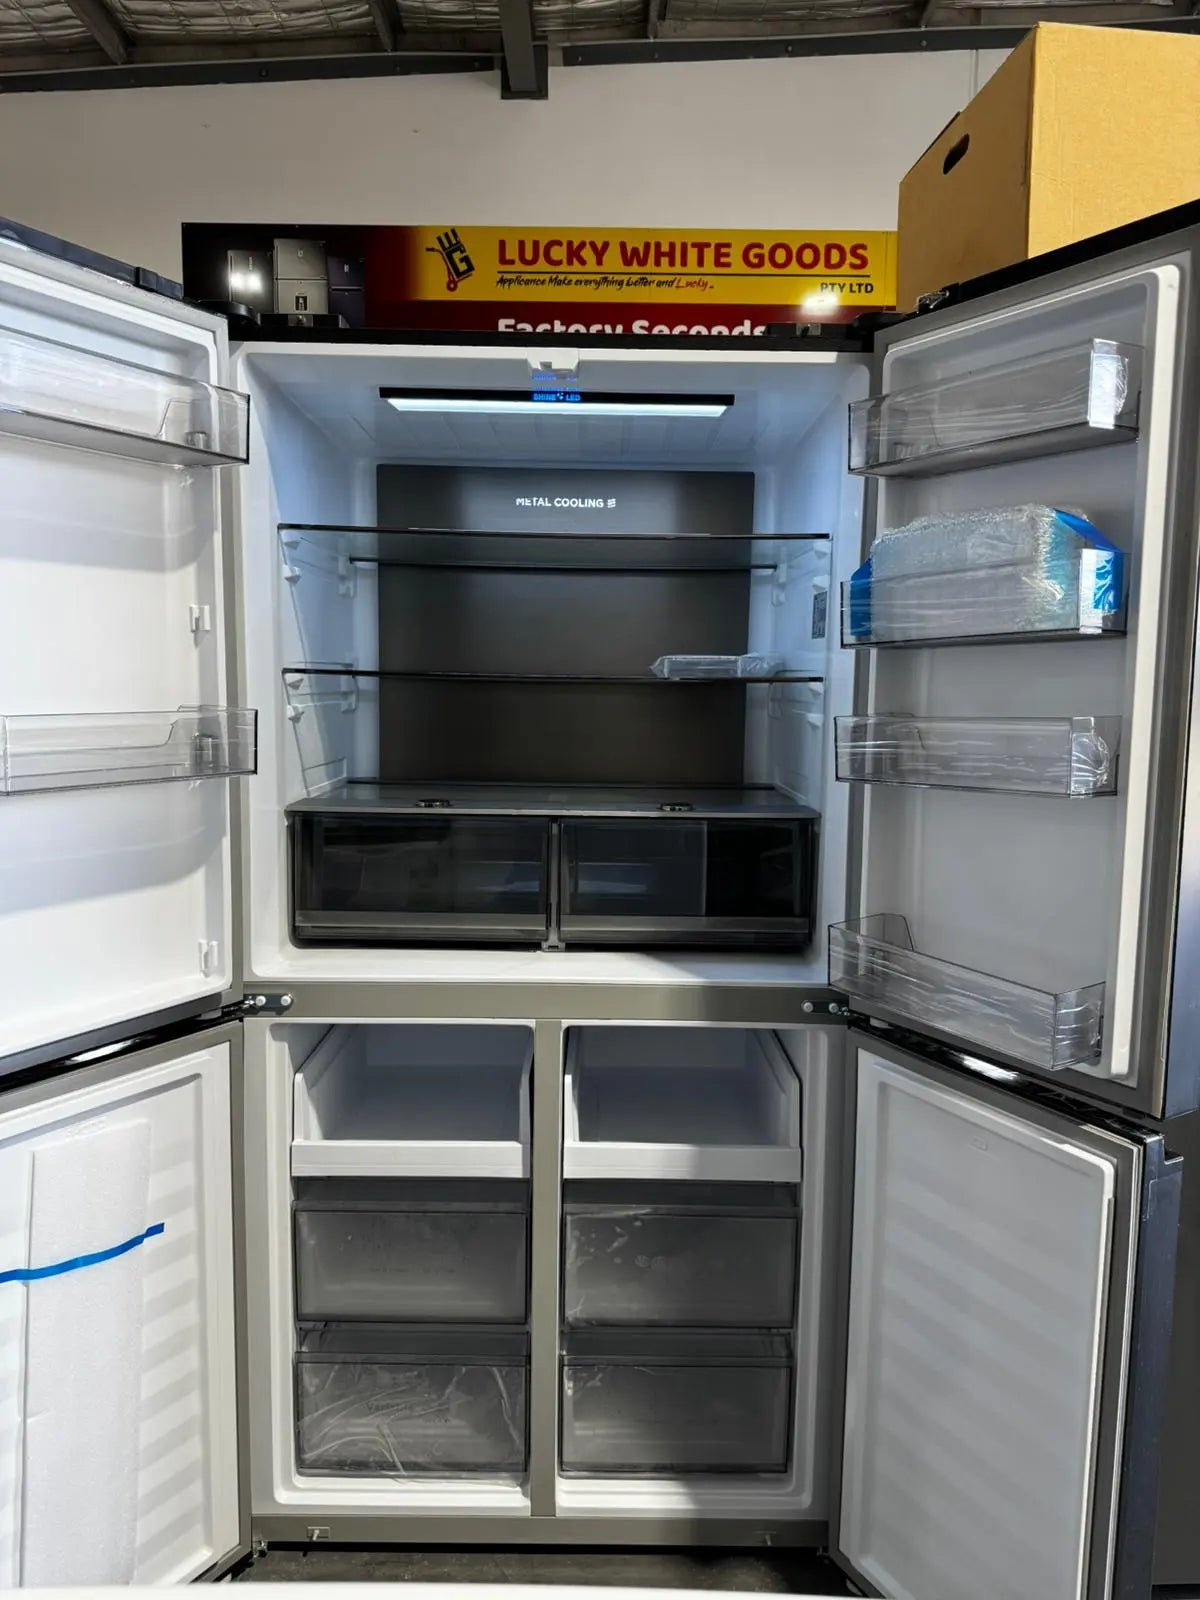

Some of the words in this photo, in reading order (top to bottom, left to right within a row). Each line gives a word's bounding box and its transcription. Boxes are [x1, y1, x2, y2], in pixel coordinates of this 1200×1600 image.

[498, 239, 610, 266] LUCKY
[619, 240, 732, 268] WHITE
[742, 242, 869, 270] GOODS
[548, 275, 572, 286] Make
[574, 275, 624, 290] everything
[656, 277, 676, 288] and
[820, 282, 846, 293] PTY
[849, 283, 874, 294] LTD
[515, 496, 552, 507] METAL
[553, 497, 604, 508] COOLING
